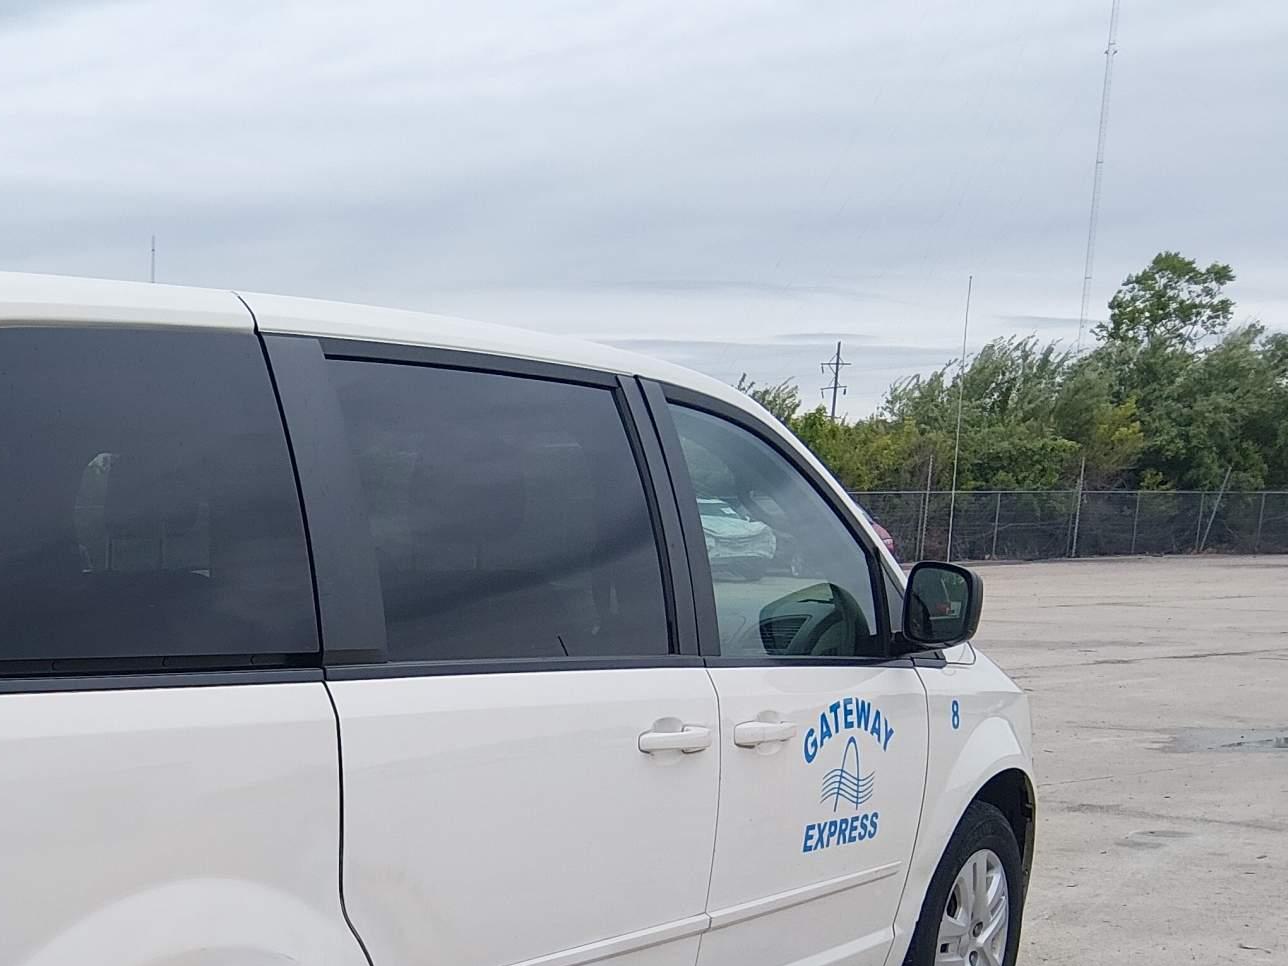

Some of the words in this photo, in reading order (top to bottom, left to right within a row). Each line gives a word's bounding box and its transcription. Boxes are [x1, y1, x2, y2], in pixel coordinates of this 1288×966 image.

[803, 697, 895, 764] GATEWAY
[950, 699, 961, 730] 8
[802, 811, 880, 853] EXPRESS
